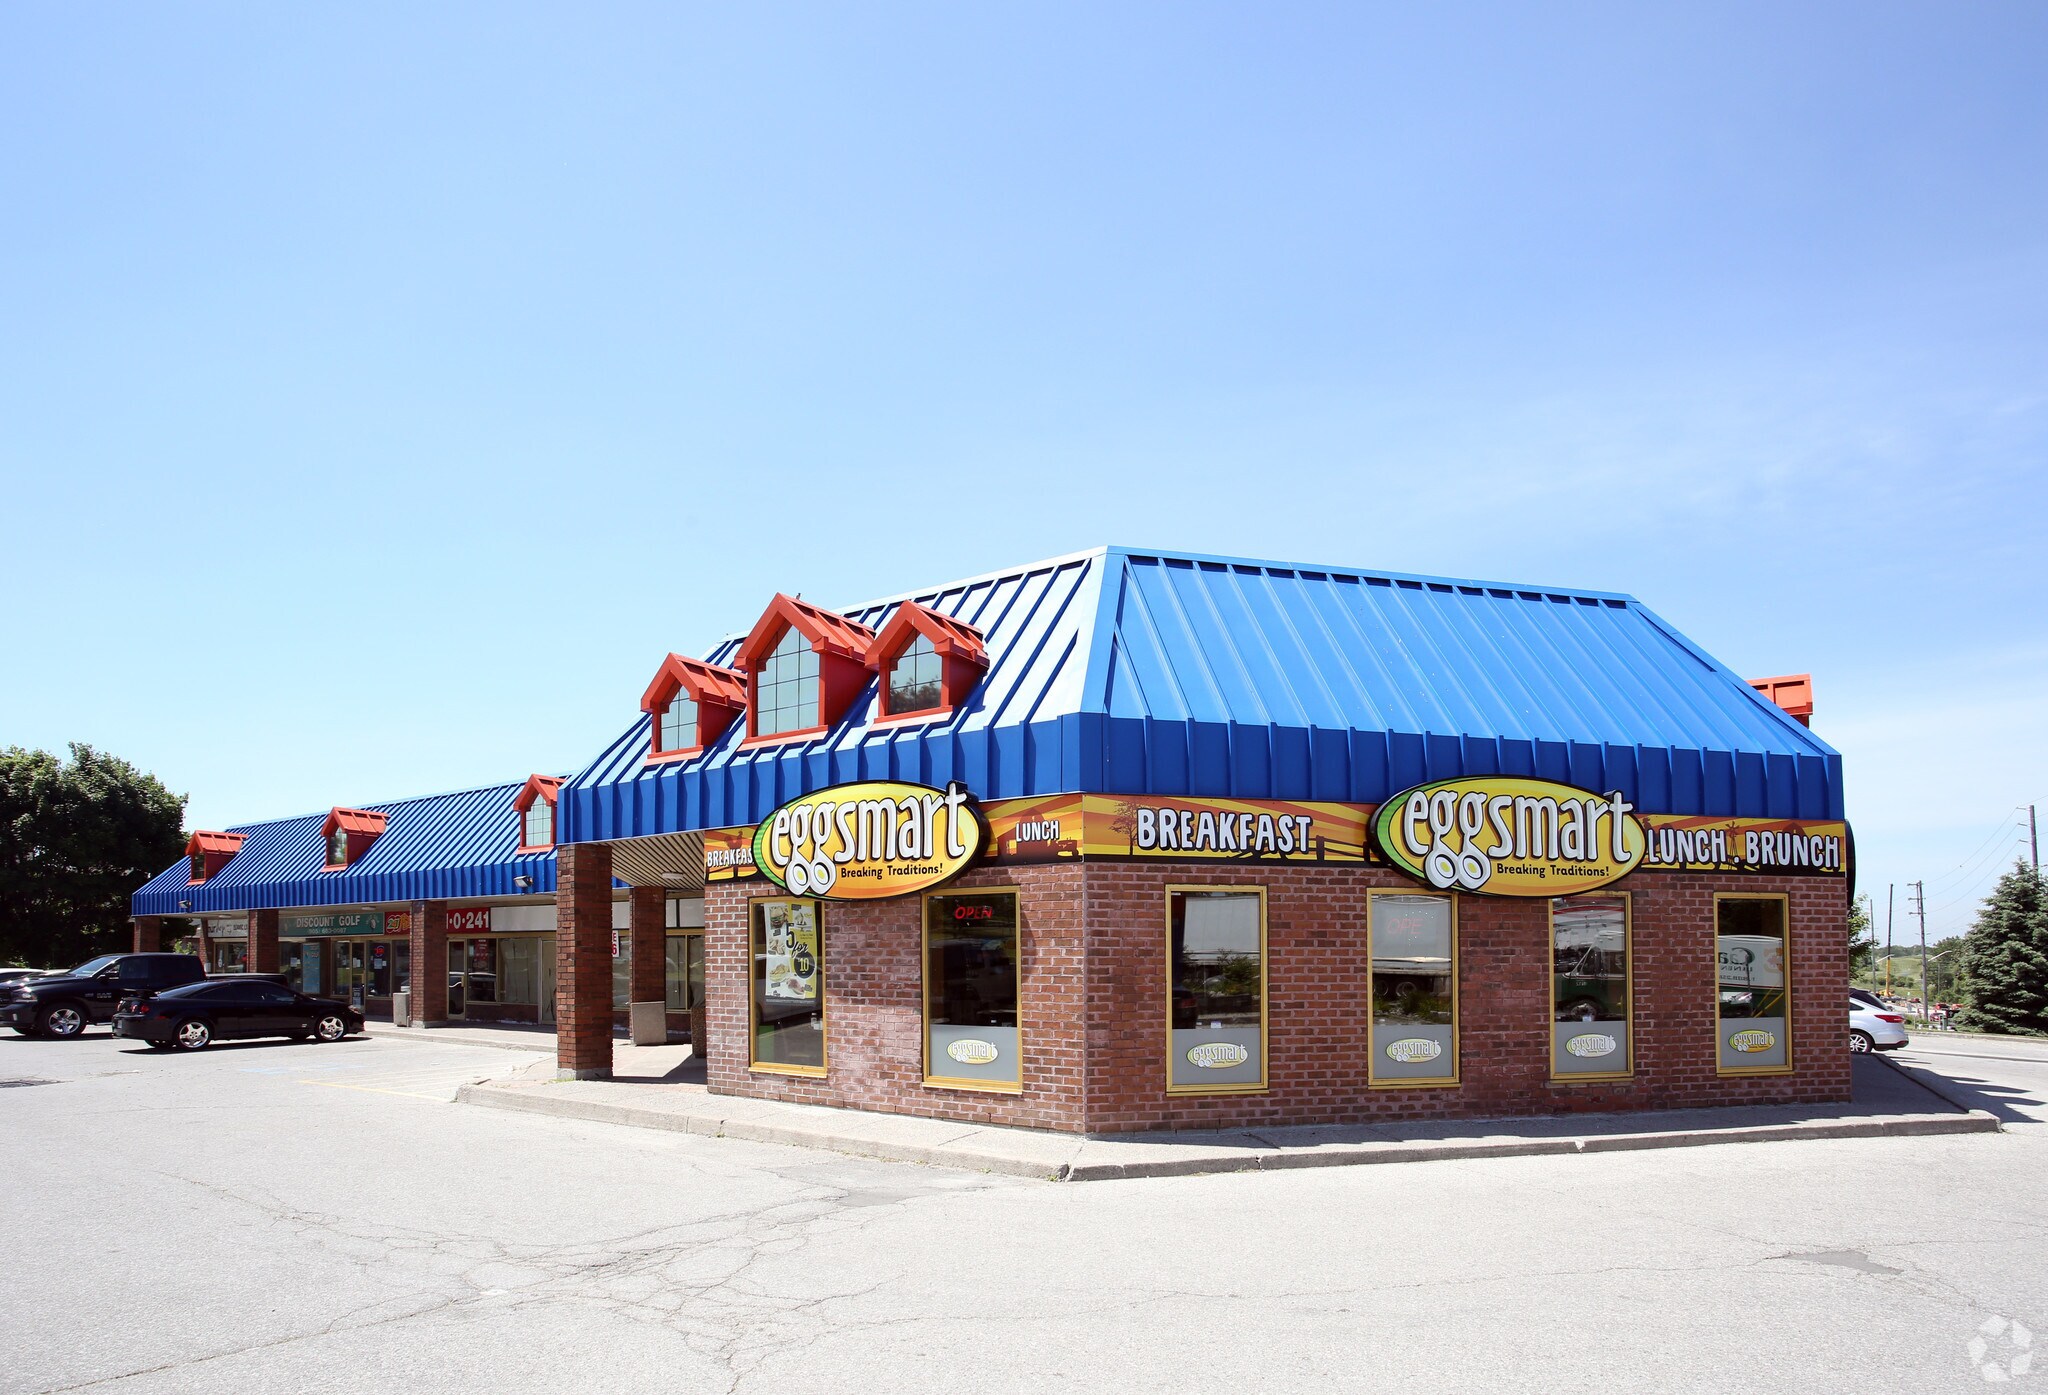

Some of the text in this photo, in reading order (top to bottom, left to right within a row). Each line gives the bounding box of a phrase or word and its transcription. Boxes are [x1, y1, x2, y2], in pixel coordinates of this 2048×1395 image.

[772, 782, 967, 896] eggsmart
[1015, 819, 1060, 843] LUNCH
[1136, 808, 1313, 853] BREAKFAST
[1404, 790, 1633, 889] eggsmart
[707, 848, 753, 867] BREAKFAS
[1647, 828, 1727, 864] LUNCH
[1745, 830, 1839, 868] BRUNCH
[841, 863, 943, 879] Breaking Traditions!
[1497, 864, 1610, 878] Breaking Traditions!
[296, 915, 361, 928] DISCOUNT GOLF
[954, 906, 993, 919] OPEN
[786, 923, 795, 949] 5
[1193, 1044, 1246, 1067] eggsmart
[1392, 1040, 1439, 1061] eggsmart
